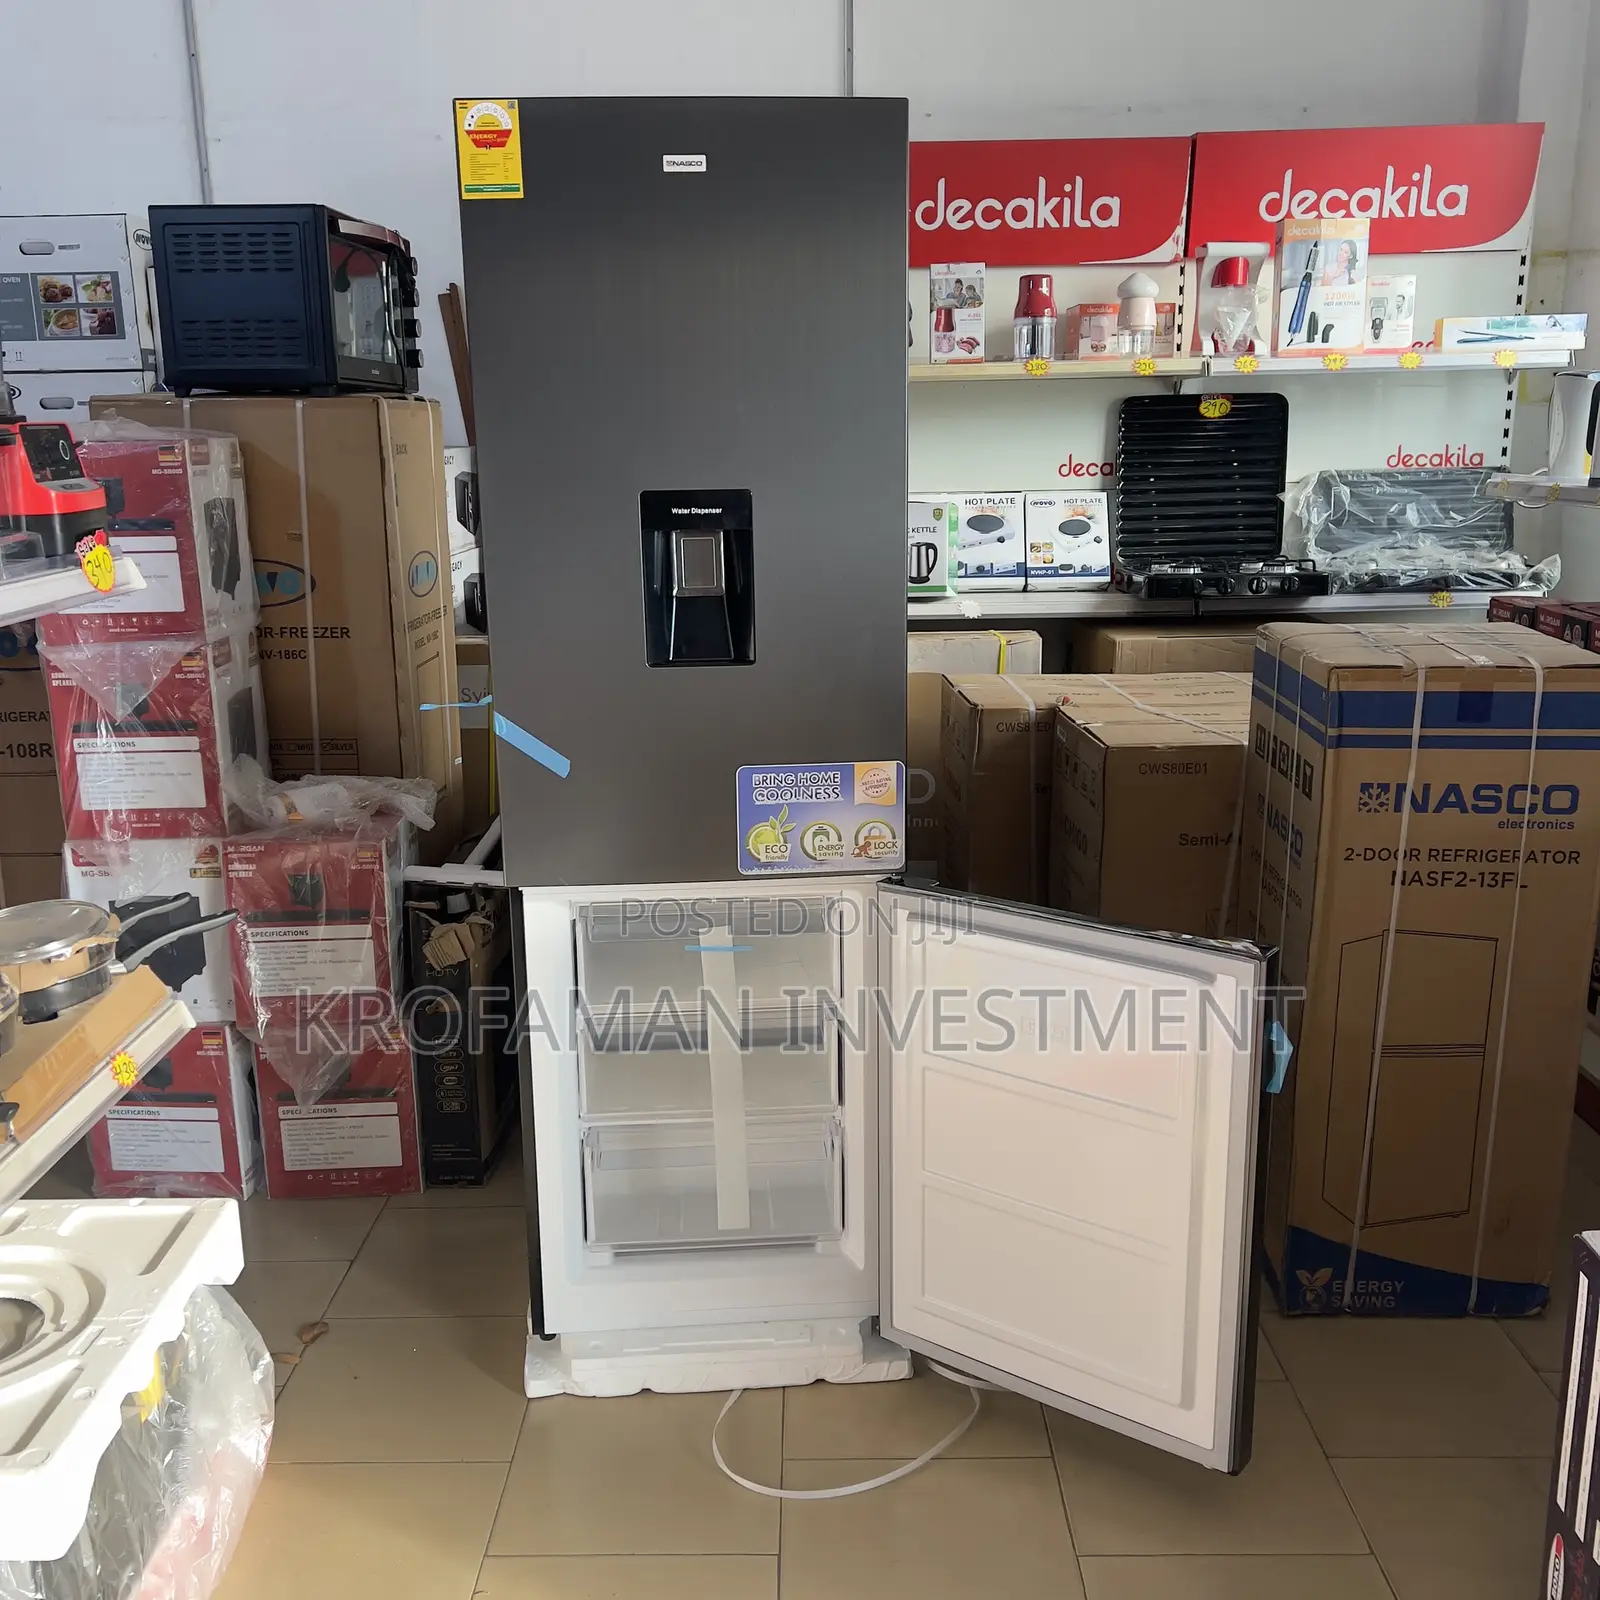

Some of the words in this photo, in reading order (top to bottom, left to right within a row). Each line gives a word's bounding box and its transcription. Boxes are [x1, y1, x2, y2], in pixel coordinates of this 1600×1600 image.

[1258, 164, 1469, 222] decakila
[915, 175, 1121, 230] decakila
[1288, 224, 1335, 237] decakila
[1203, 401, 1229, 415] 390
[1386, 444, 1484, 468] decakila
[691, 507, 722, 515] Dispenser
[1492, 607, 1511, 619] MRGAN
[1539, 614, 1561, 627] MRGAN
[331, 743, 354, 752] SILVER
[1138, 763, 1209, 775] CWS80E01
[753, 773, 795, 787] BRING
[798, 772, 841, 786] HOME
[753, 786, 841, 803] COOLNESS
[1394, 783, 1580, 815] NASCO
[1497, 818, 1575, 831] electronics
[874, 841, 898, 850] LOCK
[1179, 832, 1242, 847] Semi-A
[765, 845, 788, 854] ECO
[818, 844, 845, 852] ENERGY
[1343, 848, 1421, 863] 2-DOOR
[1427, 849, 1582, 866] REFRIGERATOR
[81, 869, 114, 878] MG-Sb
[250, 930, 309, 938] SPECIFICATIONS
[426, 968, 460, 978] HDTV
[108, 1109, 161, 1117] SPECIFICATIONS
[1333, 1281, 1405, 1293] EERGY
[1331, 1296, 1396, 1308] SVING
[1551, 1557, 1562, 1600] BOKO
